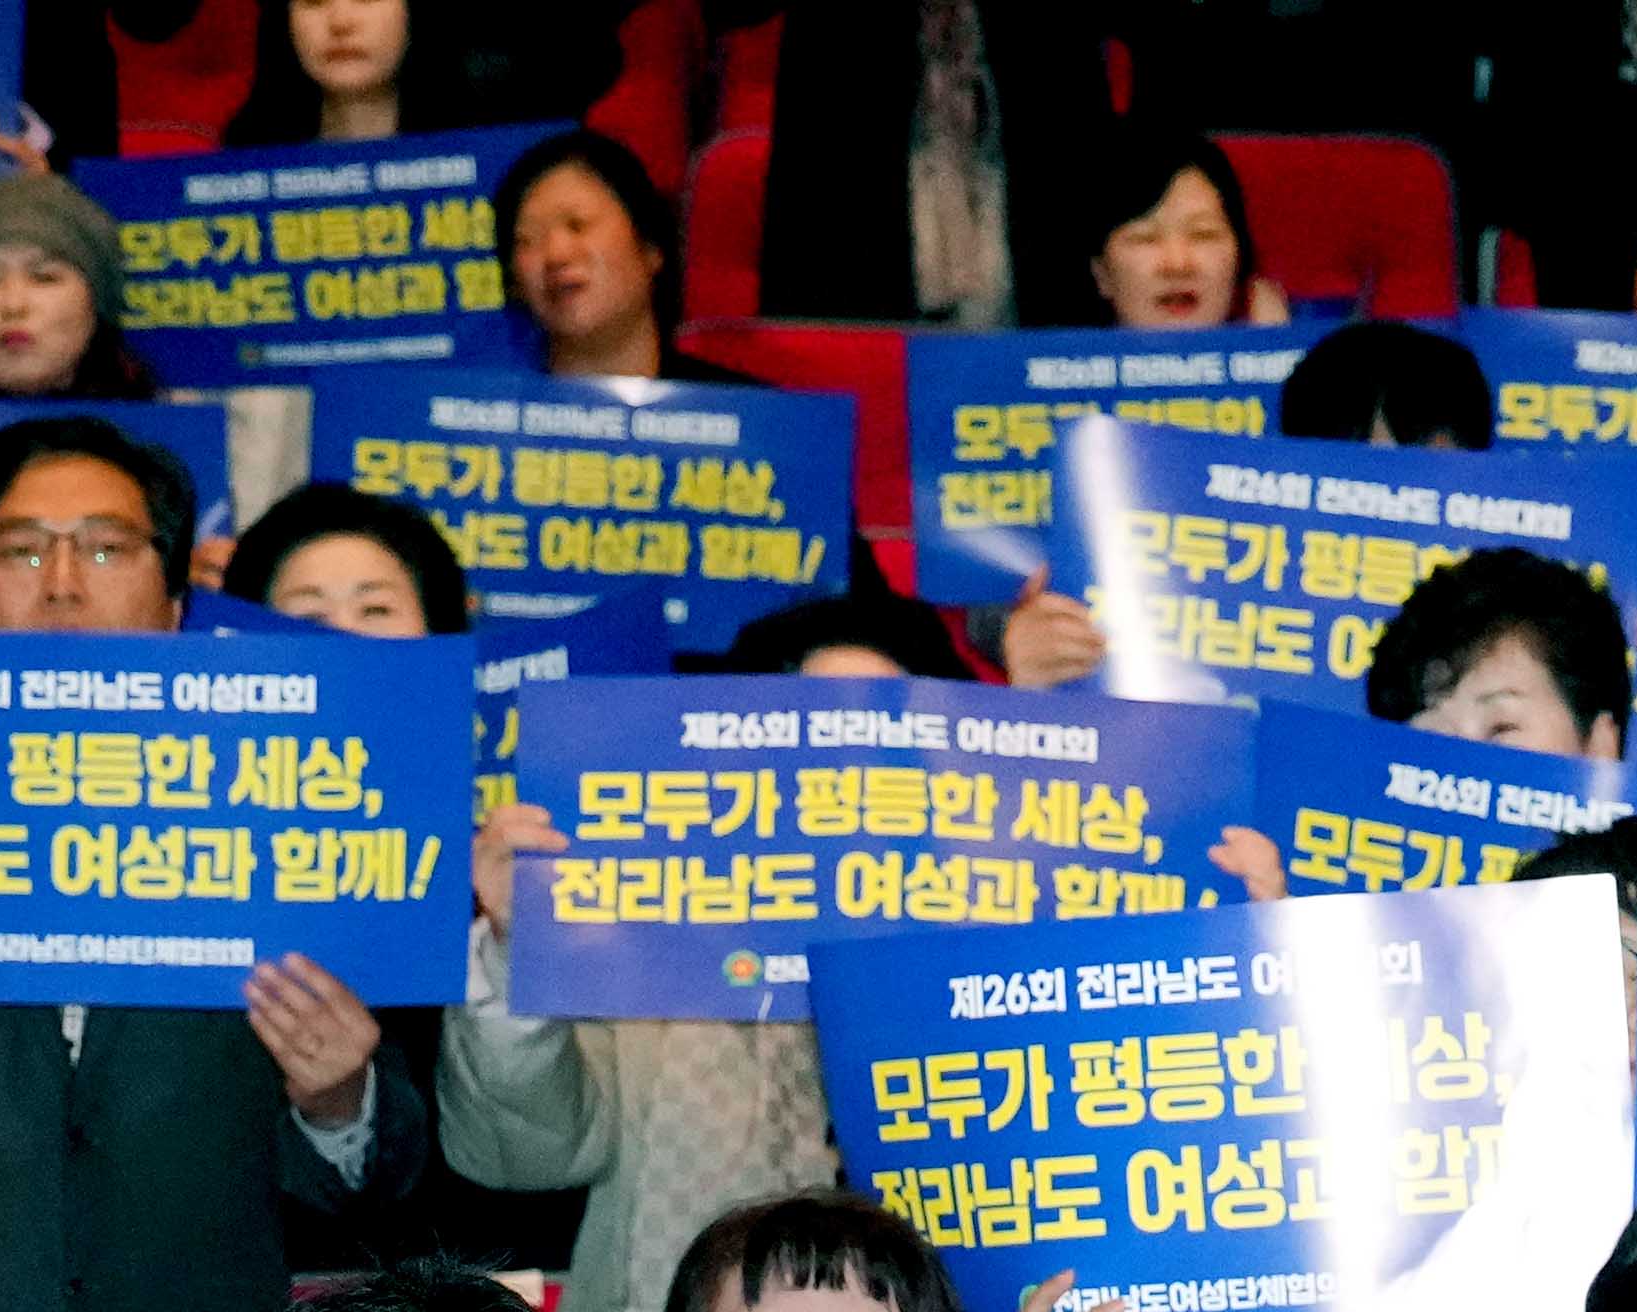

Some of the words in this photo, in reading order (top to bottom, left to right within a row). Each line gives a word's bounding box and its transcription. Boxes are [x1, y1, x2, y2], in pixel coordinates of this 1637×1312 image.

[19, 669, 165, 711] 전라남도
[172, 672, 318, 714] 여성대회
[7, 731, 216, 809] 평등한
[227, 735, 383, 818] 세상,
[680, 710, 800, 750] 제26회
[807, 709, 951, 753] 전라남도
[956, 717, 1099, 764] 여성대회
[576, 768, 782, 841] 모두가
[794, 765, 1001, 843] 평등한
[1009, 778, 1163, 864] 세상,
[50, 824, 258, 902] 여성과
[270, 827, 441, 903] 함께!
[551, 853, 819, 927] 전라남도
[835, 850, 1041, 925] 여성과
[948, 967, 1067, 1020] 제26회
[1076, 954, 1242, 1010] 전라남도
[871, 1044, 1055, 1142] 모두가
[1069, 1025, 1314, 1128] 평등한
[872, 1154, 1107, 1249] 전라남도
